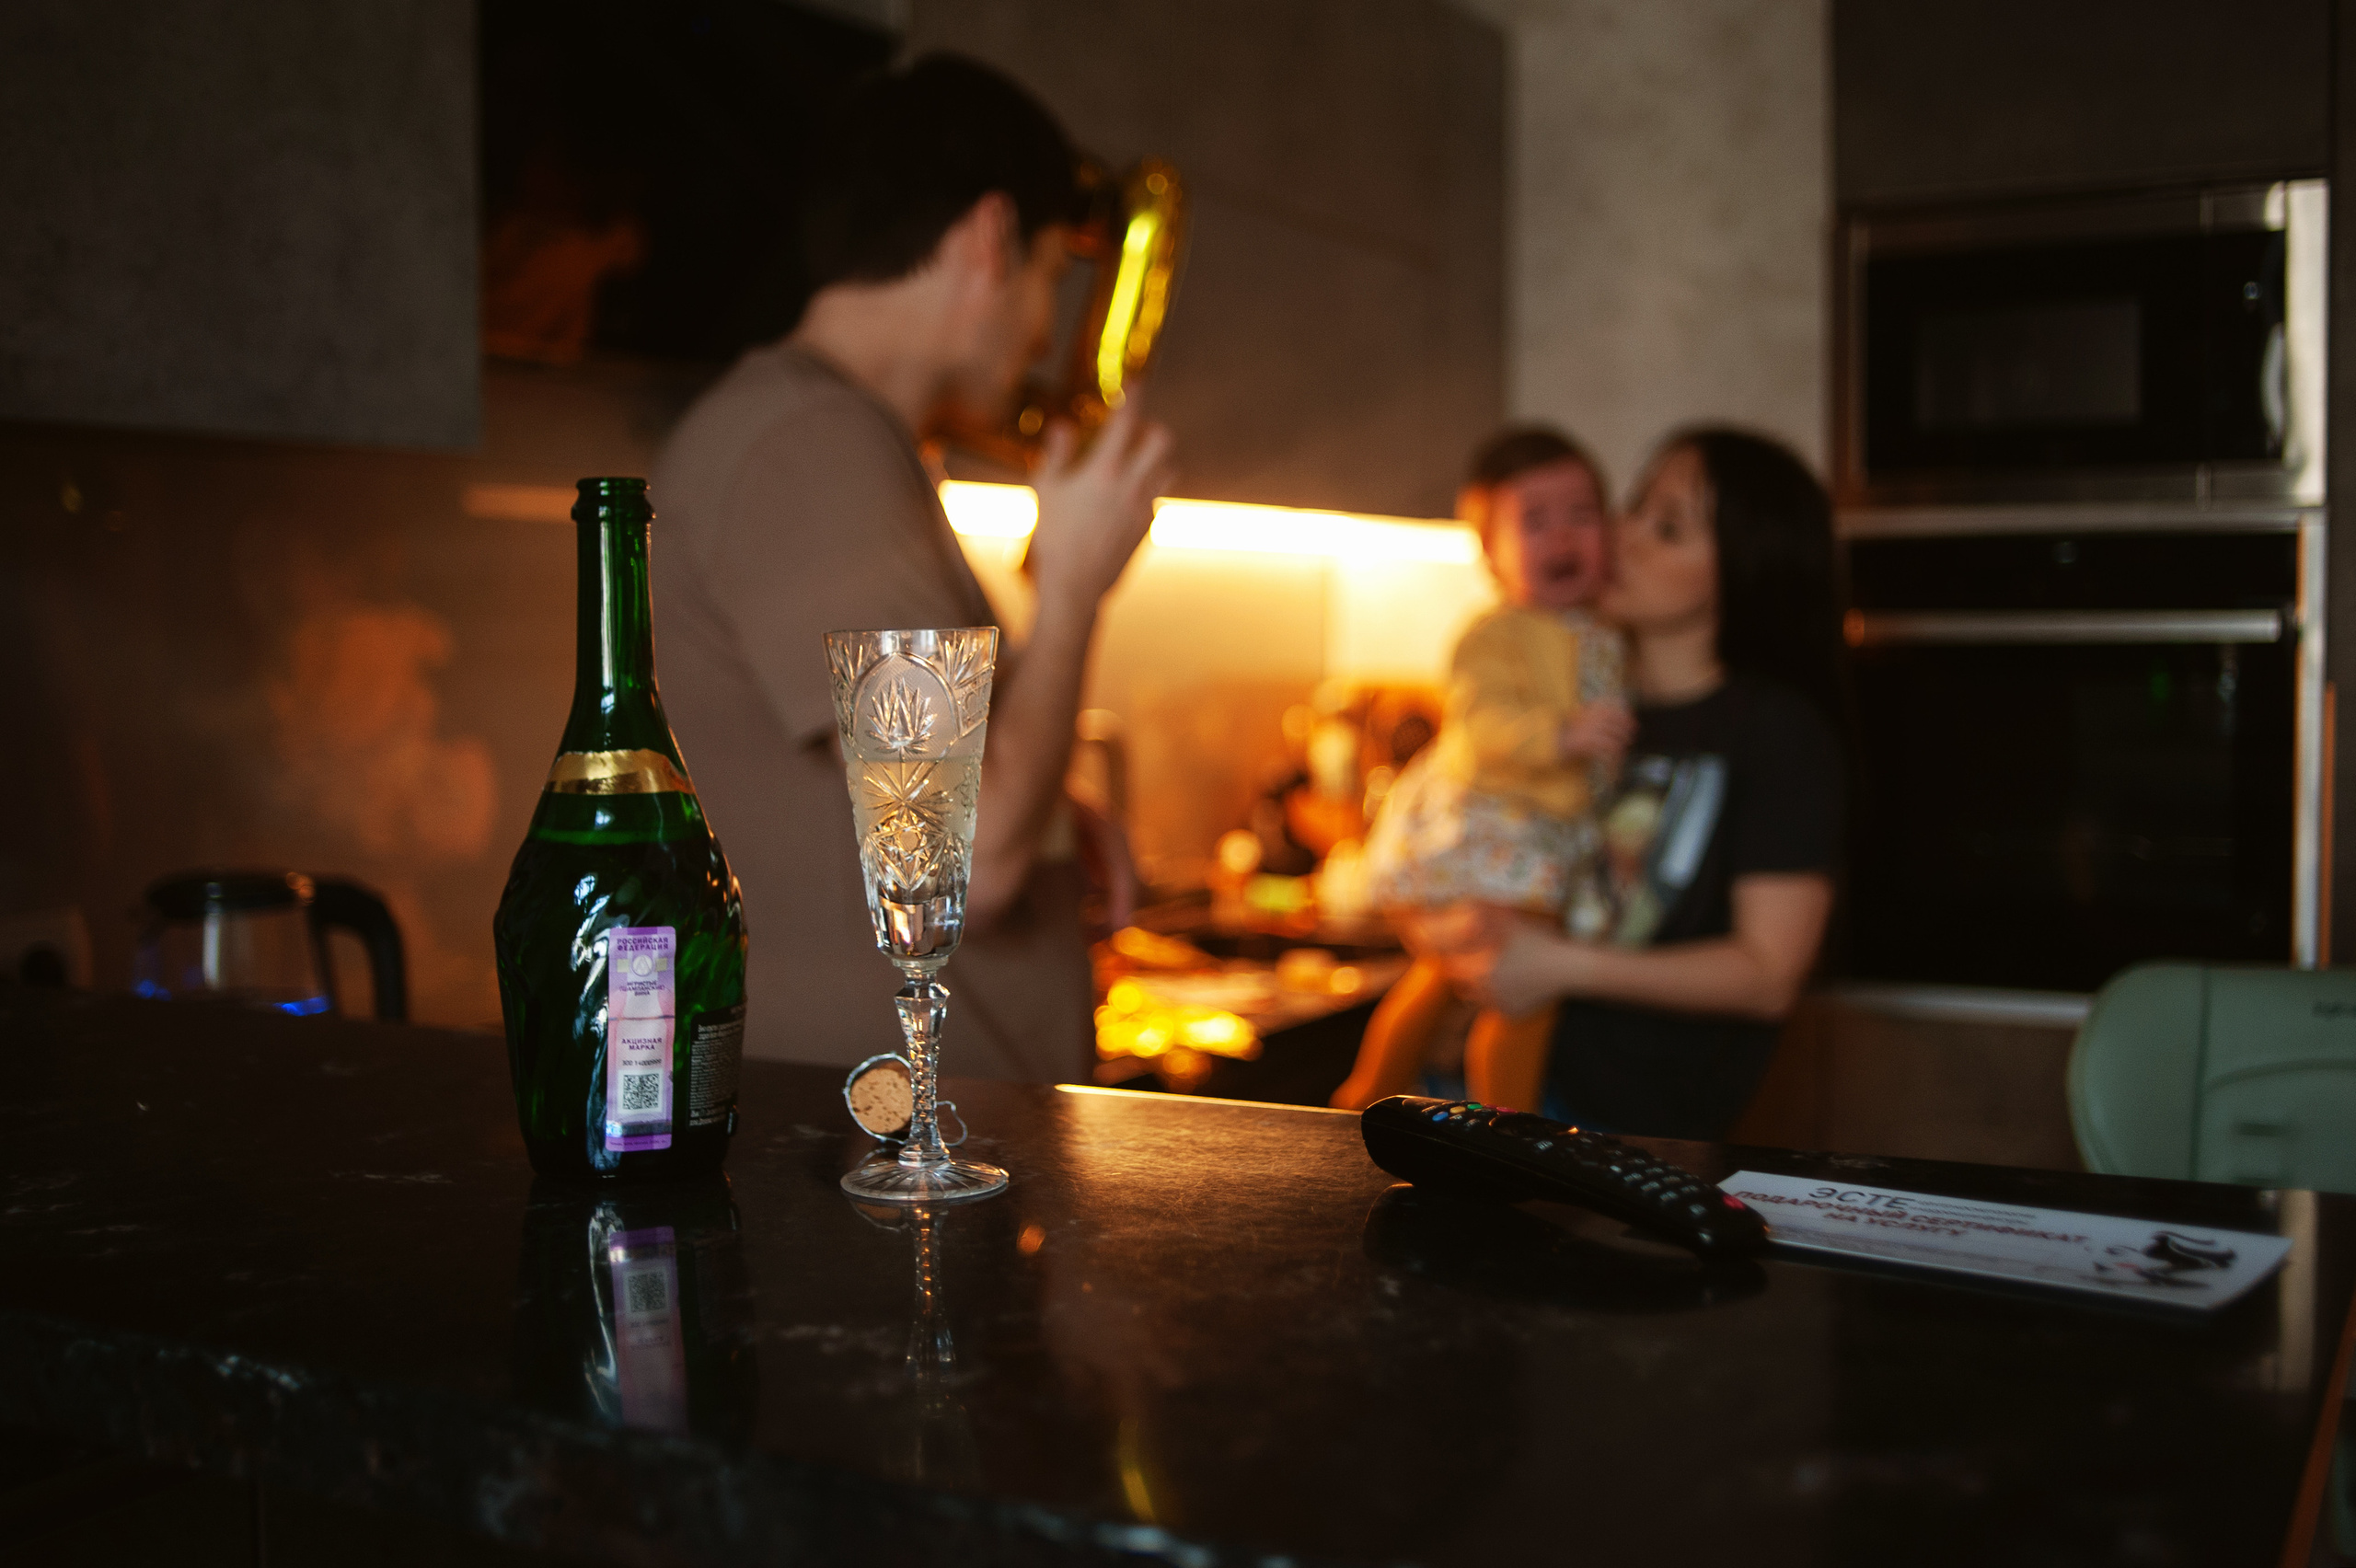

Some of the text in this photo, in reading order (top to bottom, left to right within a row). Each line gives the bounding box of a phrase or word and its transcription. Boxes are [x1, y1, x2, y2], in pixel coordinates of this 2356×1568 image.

[617, 937, 669, 945] РОССИЙСКАЯ
[622, 1037, 662, 1045] АКЦИЗНАЯ
[1808, 1187, 1915, 1209] ЭСТЕ
[1733, 1191, 1908, 1219] ПОДАРОЧНЫЙ
[1910, 1215, 2089, 1242] СЕРТИФИКАТ
